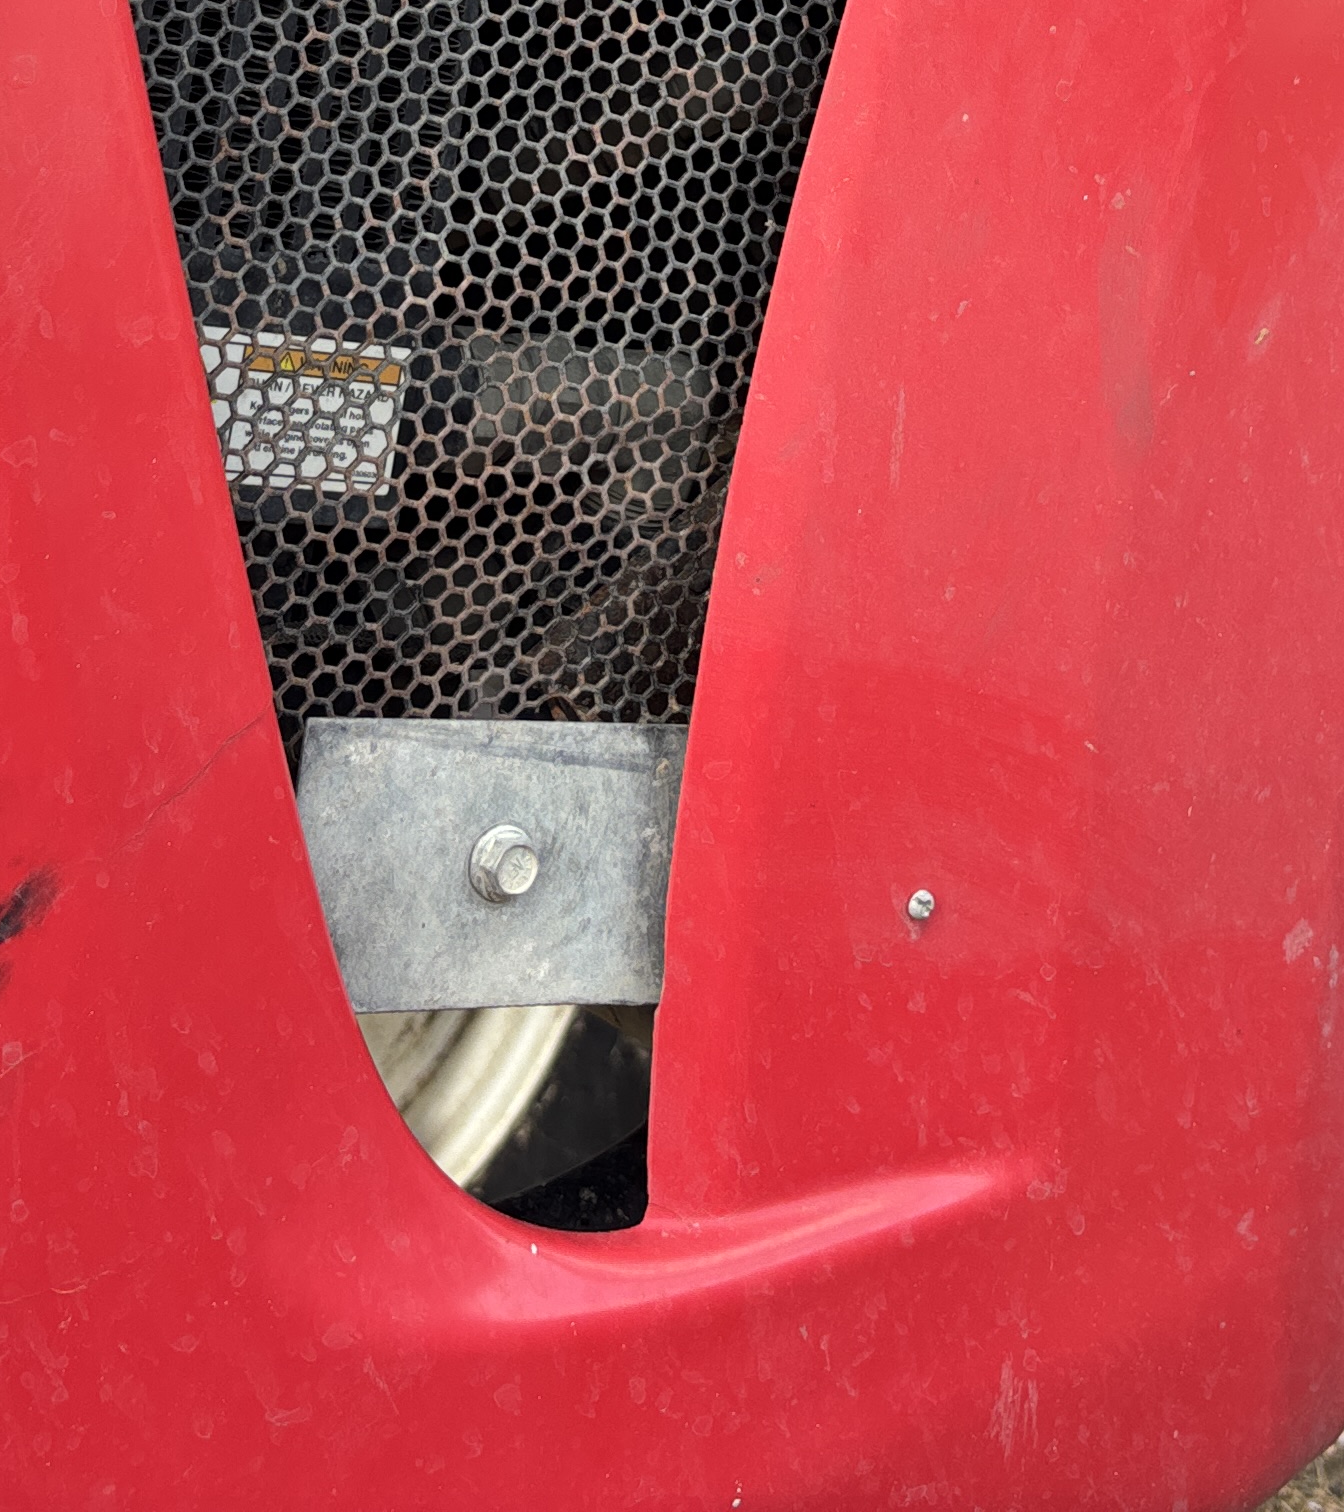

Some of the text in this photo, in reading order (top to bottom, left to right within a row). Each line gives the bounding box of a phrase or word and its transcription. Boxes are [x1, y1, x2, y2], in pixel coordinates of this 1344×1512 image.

[300, 356, 369, 376] ANIN
[297, 382, 335, 397] EVER
[338, 386, 390, 402] AZAD
